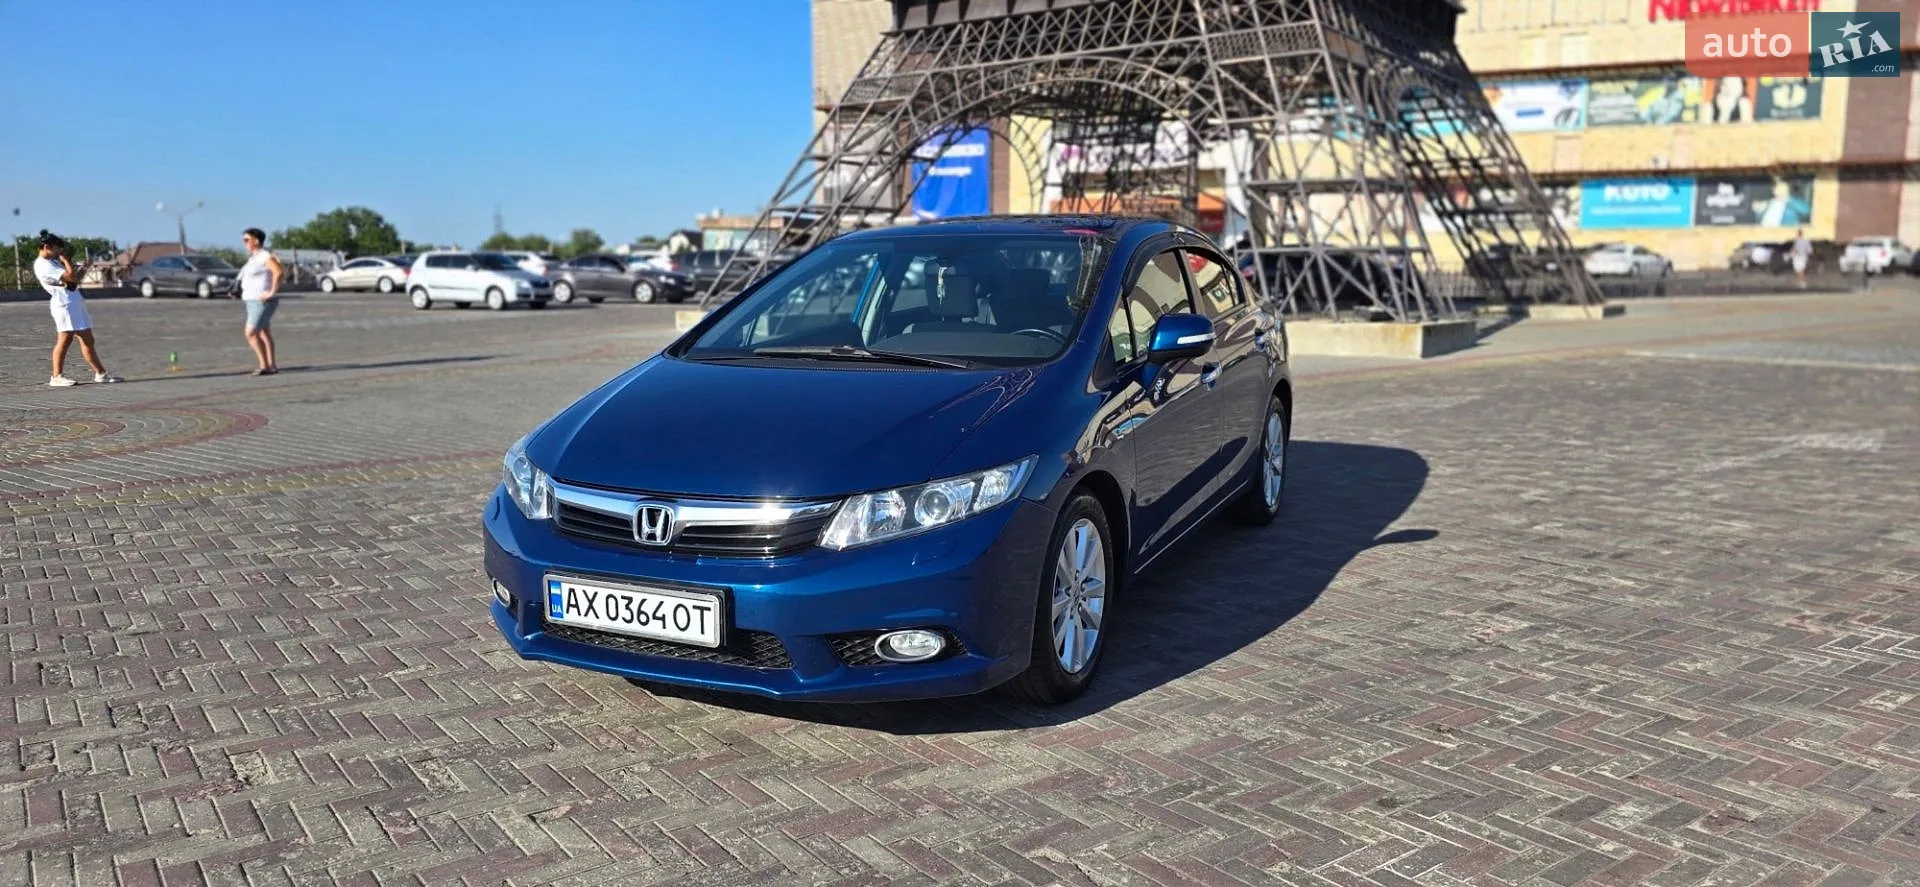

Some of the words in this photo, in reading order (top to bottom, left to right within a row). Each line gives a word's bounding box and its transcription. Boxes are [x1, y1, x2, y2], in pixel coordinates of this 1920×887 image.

[551, 604, 563, 614] UA
[566, 587, 600, 619] AX
[605, 594, 667, 630] 0364
[673, 603, 711, 635] OT
